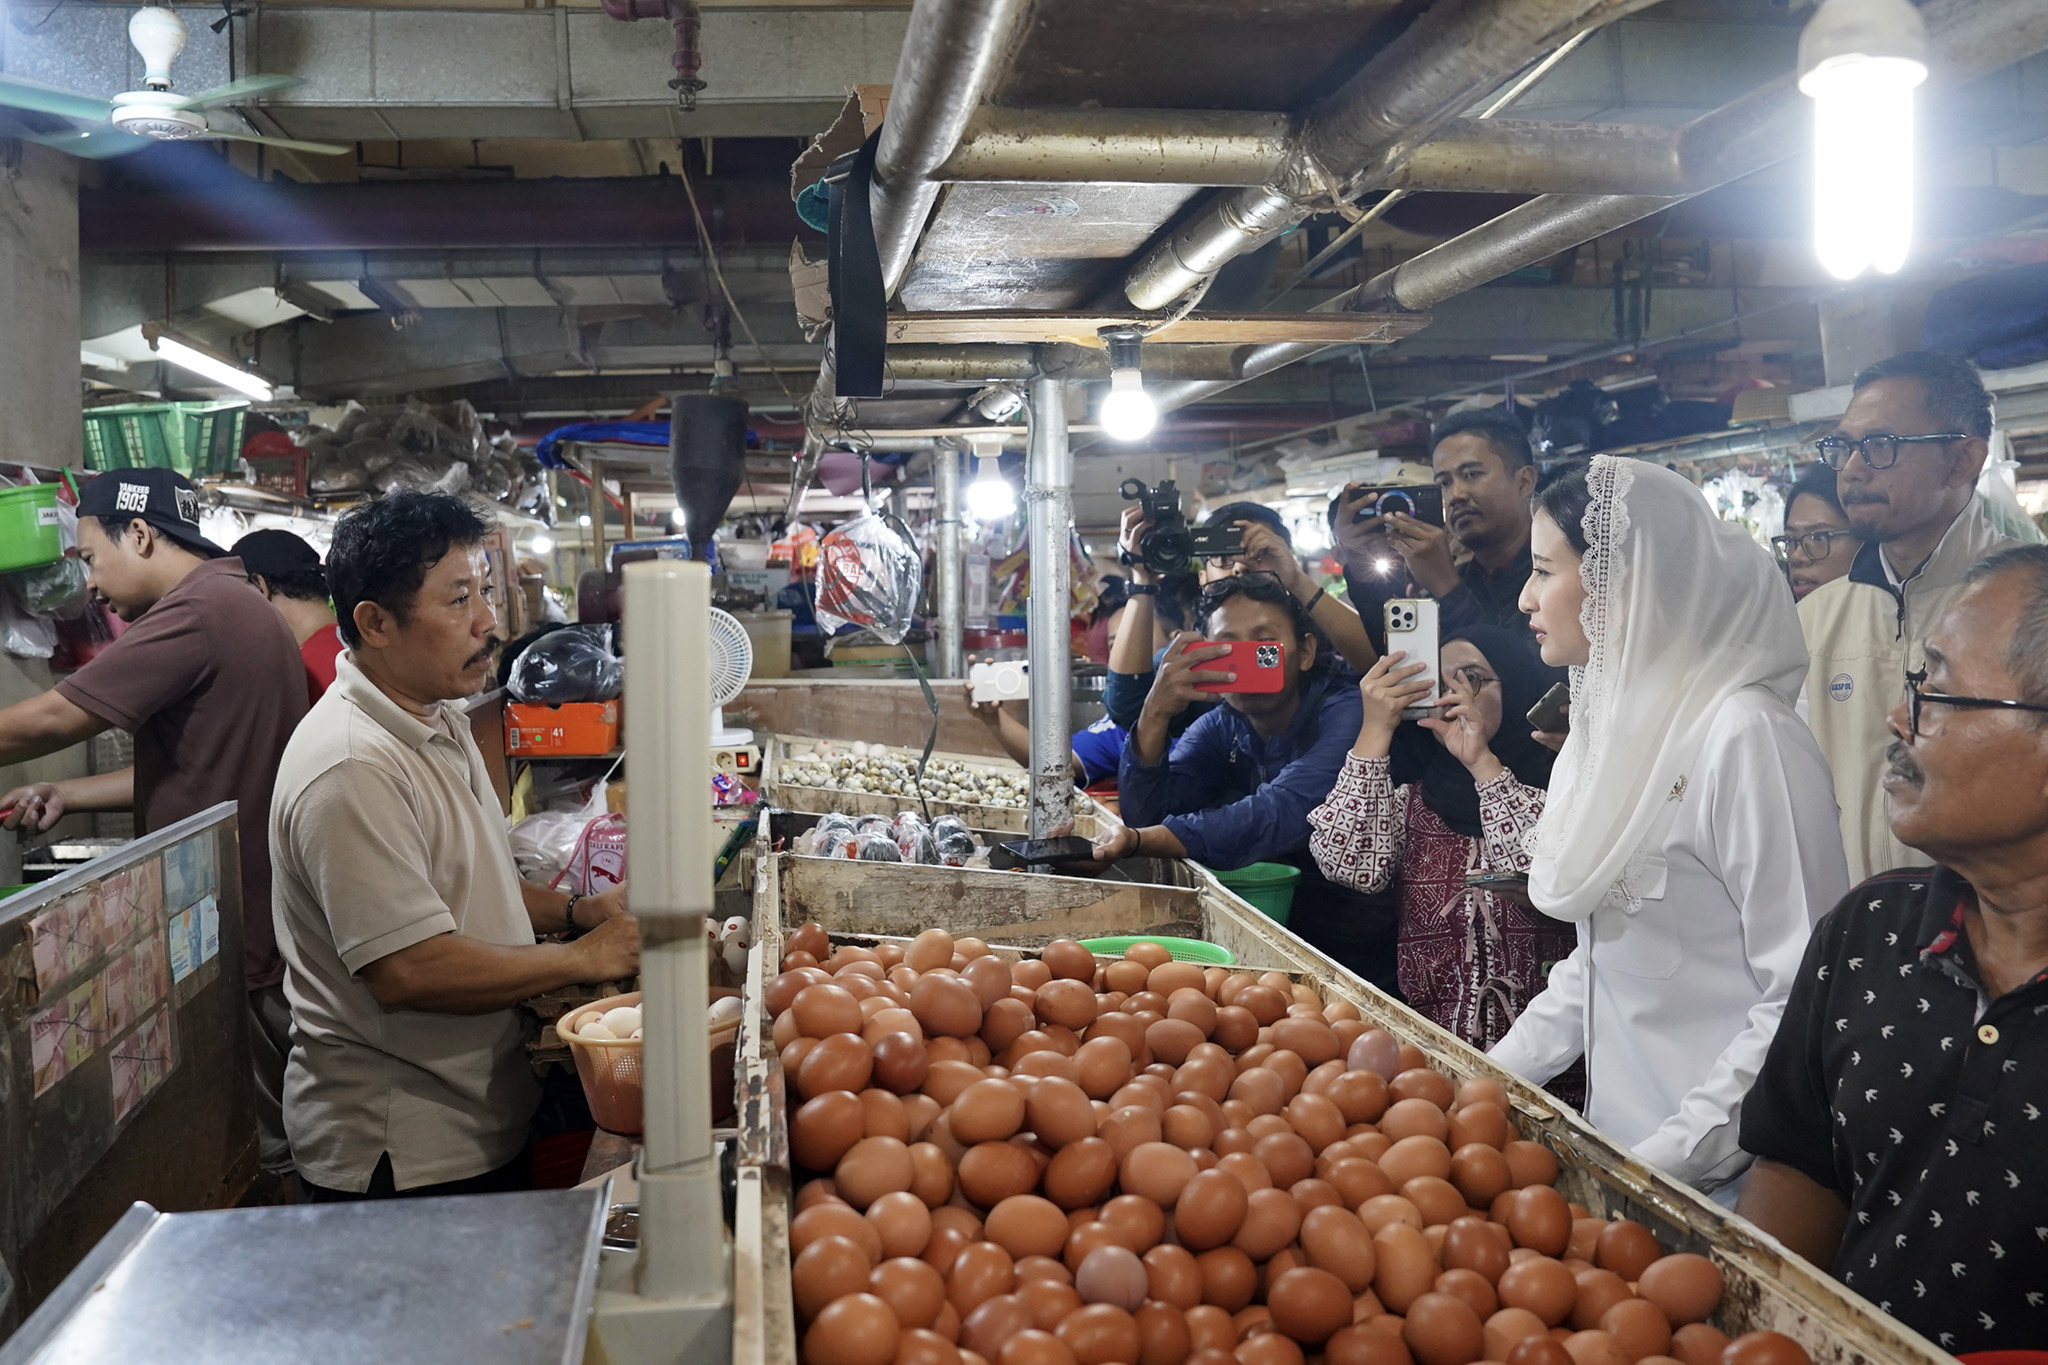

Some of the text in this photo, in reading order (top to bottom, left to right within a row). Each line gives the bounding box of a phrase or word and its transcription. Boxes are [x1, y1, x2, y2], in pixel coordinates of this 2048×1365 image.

[119, 482, 150, 494] YANKEES
[116, 491, 148, 513] 1903
[552, 727, 563, 737] 41
